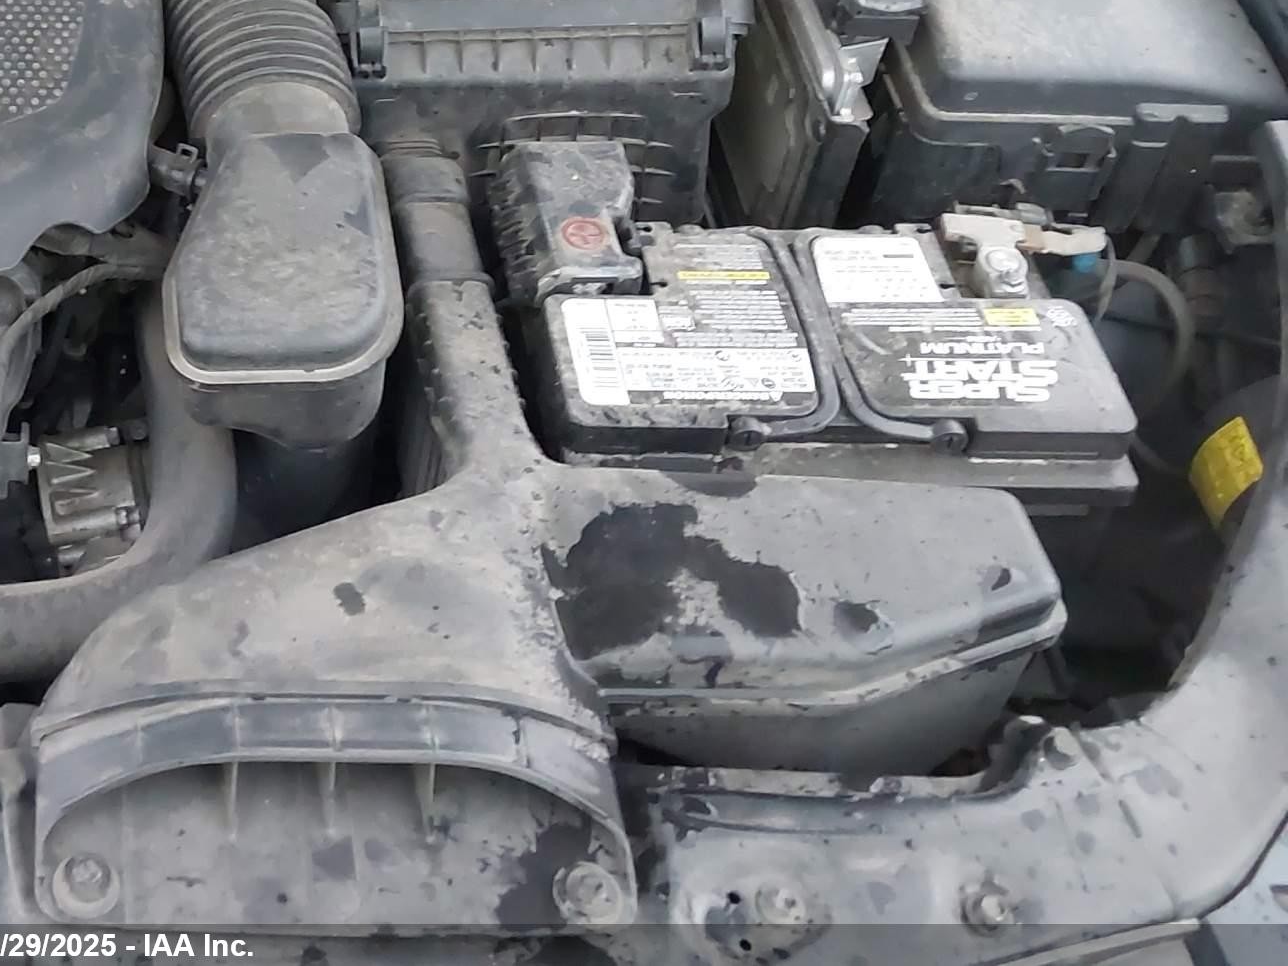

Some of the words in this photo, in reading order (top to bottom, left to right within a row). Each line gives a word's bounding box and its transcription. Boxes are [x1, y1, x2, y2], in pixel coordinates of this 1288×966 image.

[919, 342, 1046, 355] PLATINUM
[900, 360, 1058, 385] START
[908, 380, 1051, 403] SUPER
